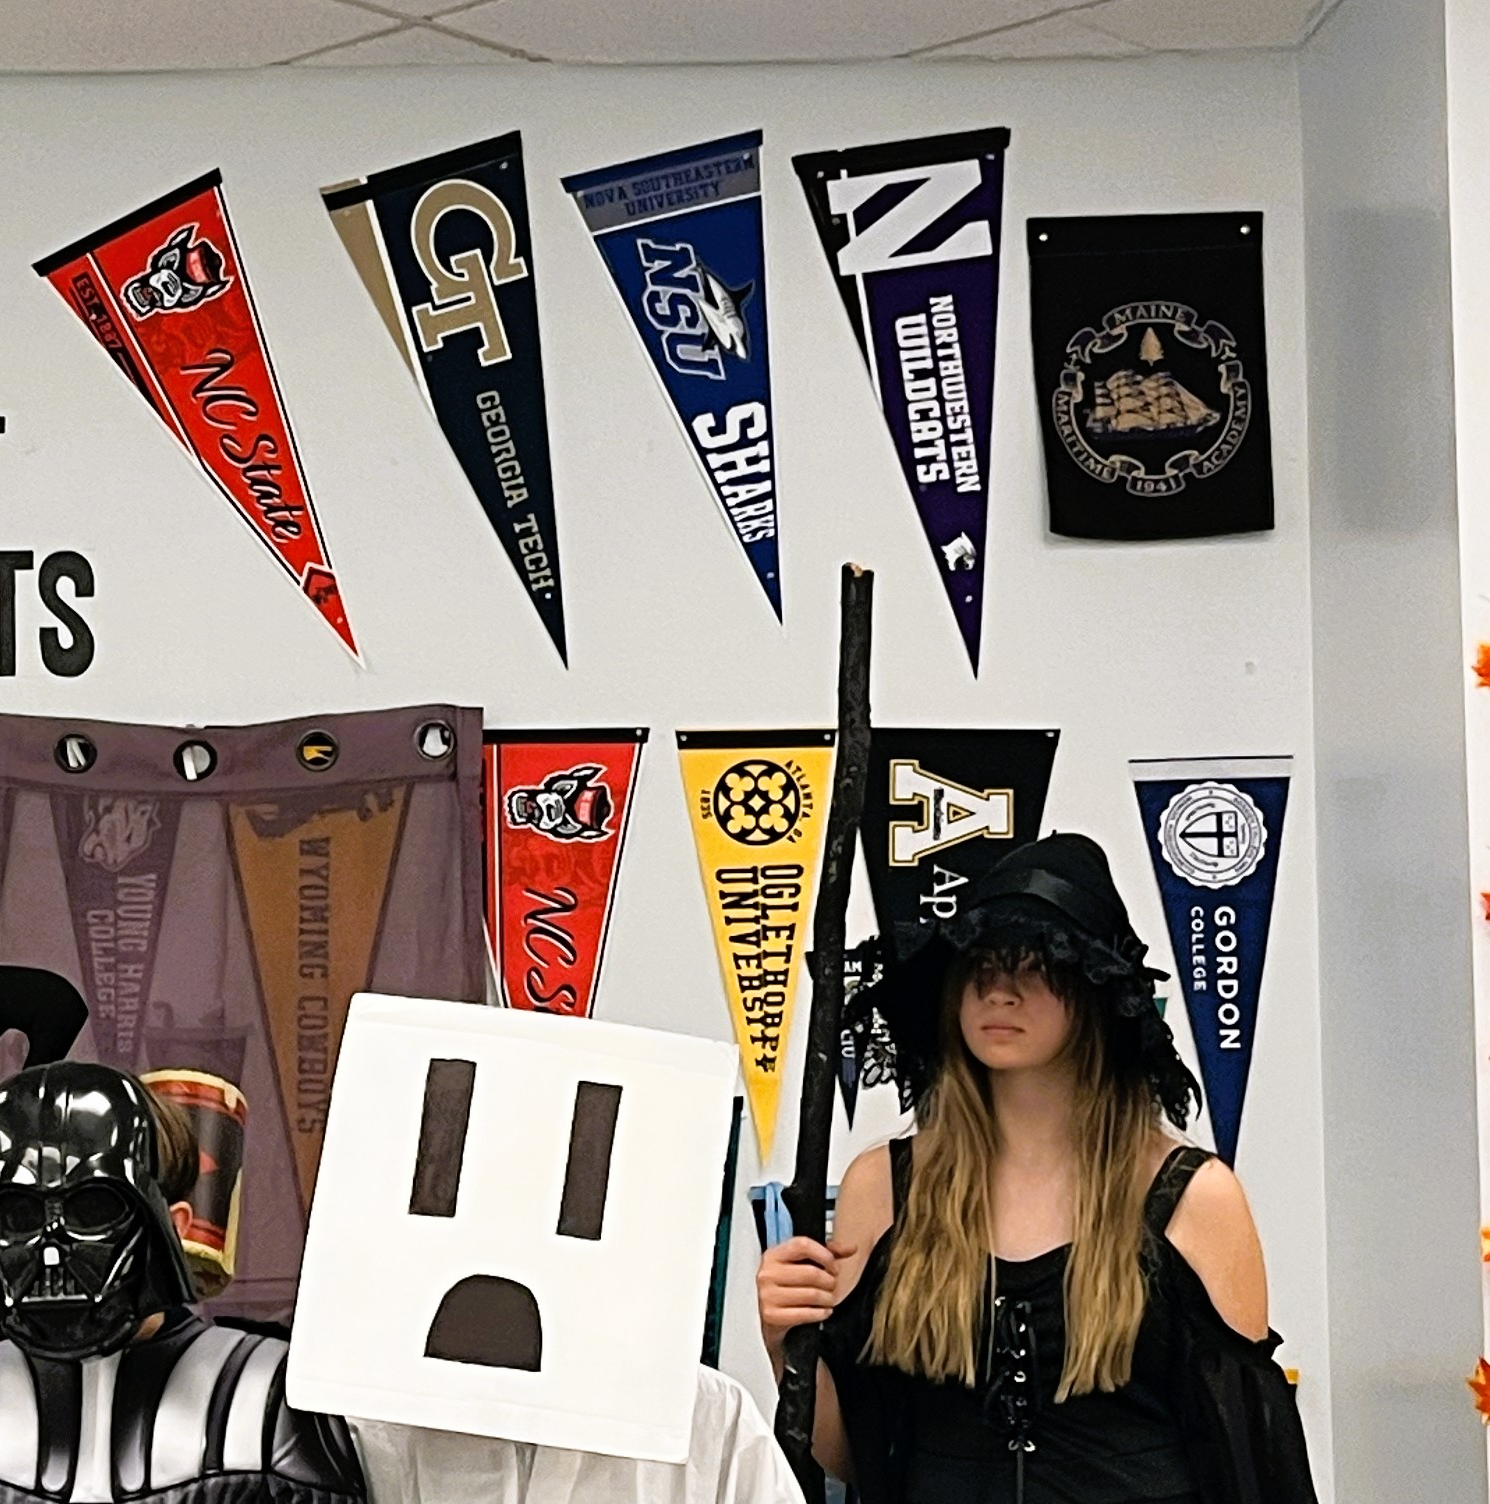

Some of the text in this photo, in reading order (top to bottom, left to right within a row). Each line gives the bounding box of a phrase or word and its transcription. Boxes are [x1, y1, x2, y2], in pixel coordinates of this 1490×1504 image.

[584, 155, 755, 209] NOVA SOUTHEASTERN
[625, 181, 721, 216] UNIVERSITY
[826, 159, 993, 276] N
[637, 238, 726, 381] NSU
[1113, 304, 1188, 326] MAINE
[180, 348, 303, 544] NC State
[894, 313, 950, 484] WILDCATS
[928, 295, 982, 493] NORTHWESTERN
[1056, 389, 1112, 479] MARITIME
[1201, 380, 1247, 474] ACADEMY
[476, 390, 556, 593] GEORGIA TECH
[691, 401, 776, 544] SHARKS
[1135, 477, 1179, 493] 1941
[889, 759, 1014, 867] A
[86, 910, 115, 1019] COLLEGE
[116, 872, 157, 1053] YOUNG HARRIS
[521, 886, 578, 968] NC
[1189, 905, 1207, 992] COLLEGE
[1213, 905, 1241, 1050] GORDON
[296, 836, 331, 1135] WYOMING COWBOYS
